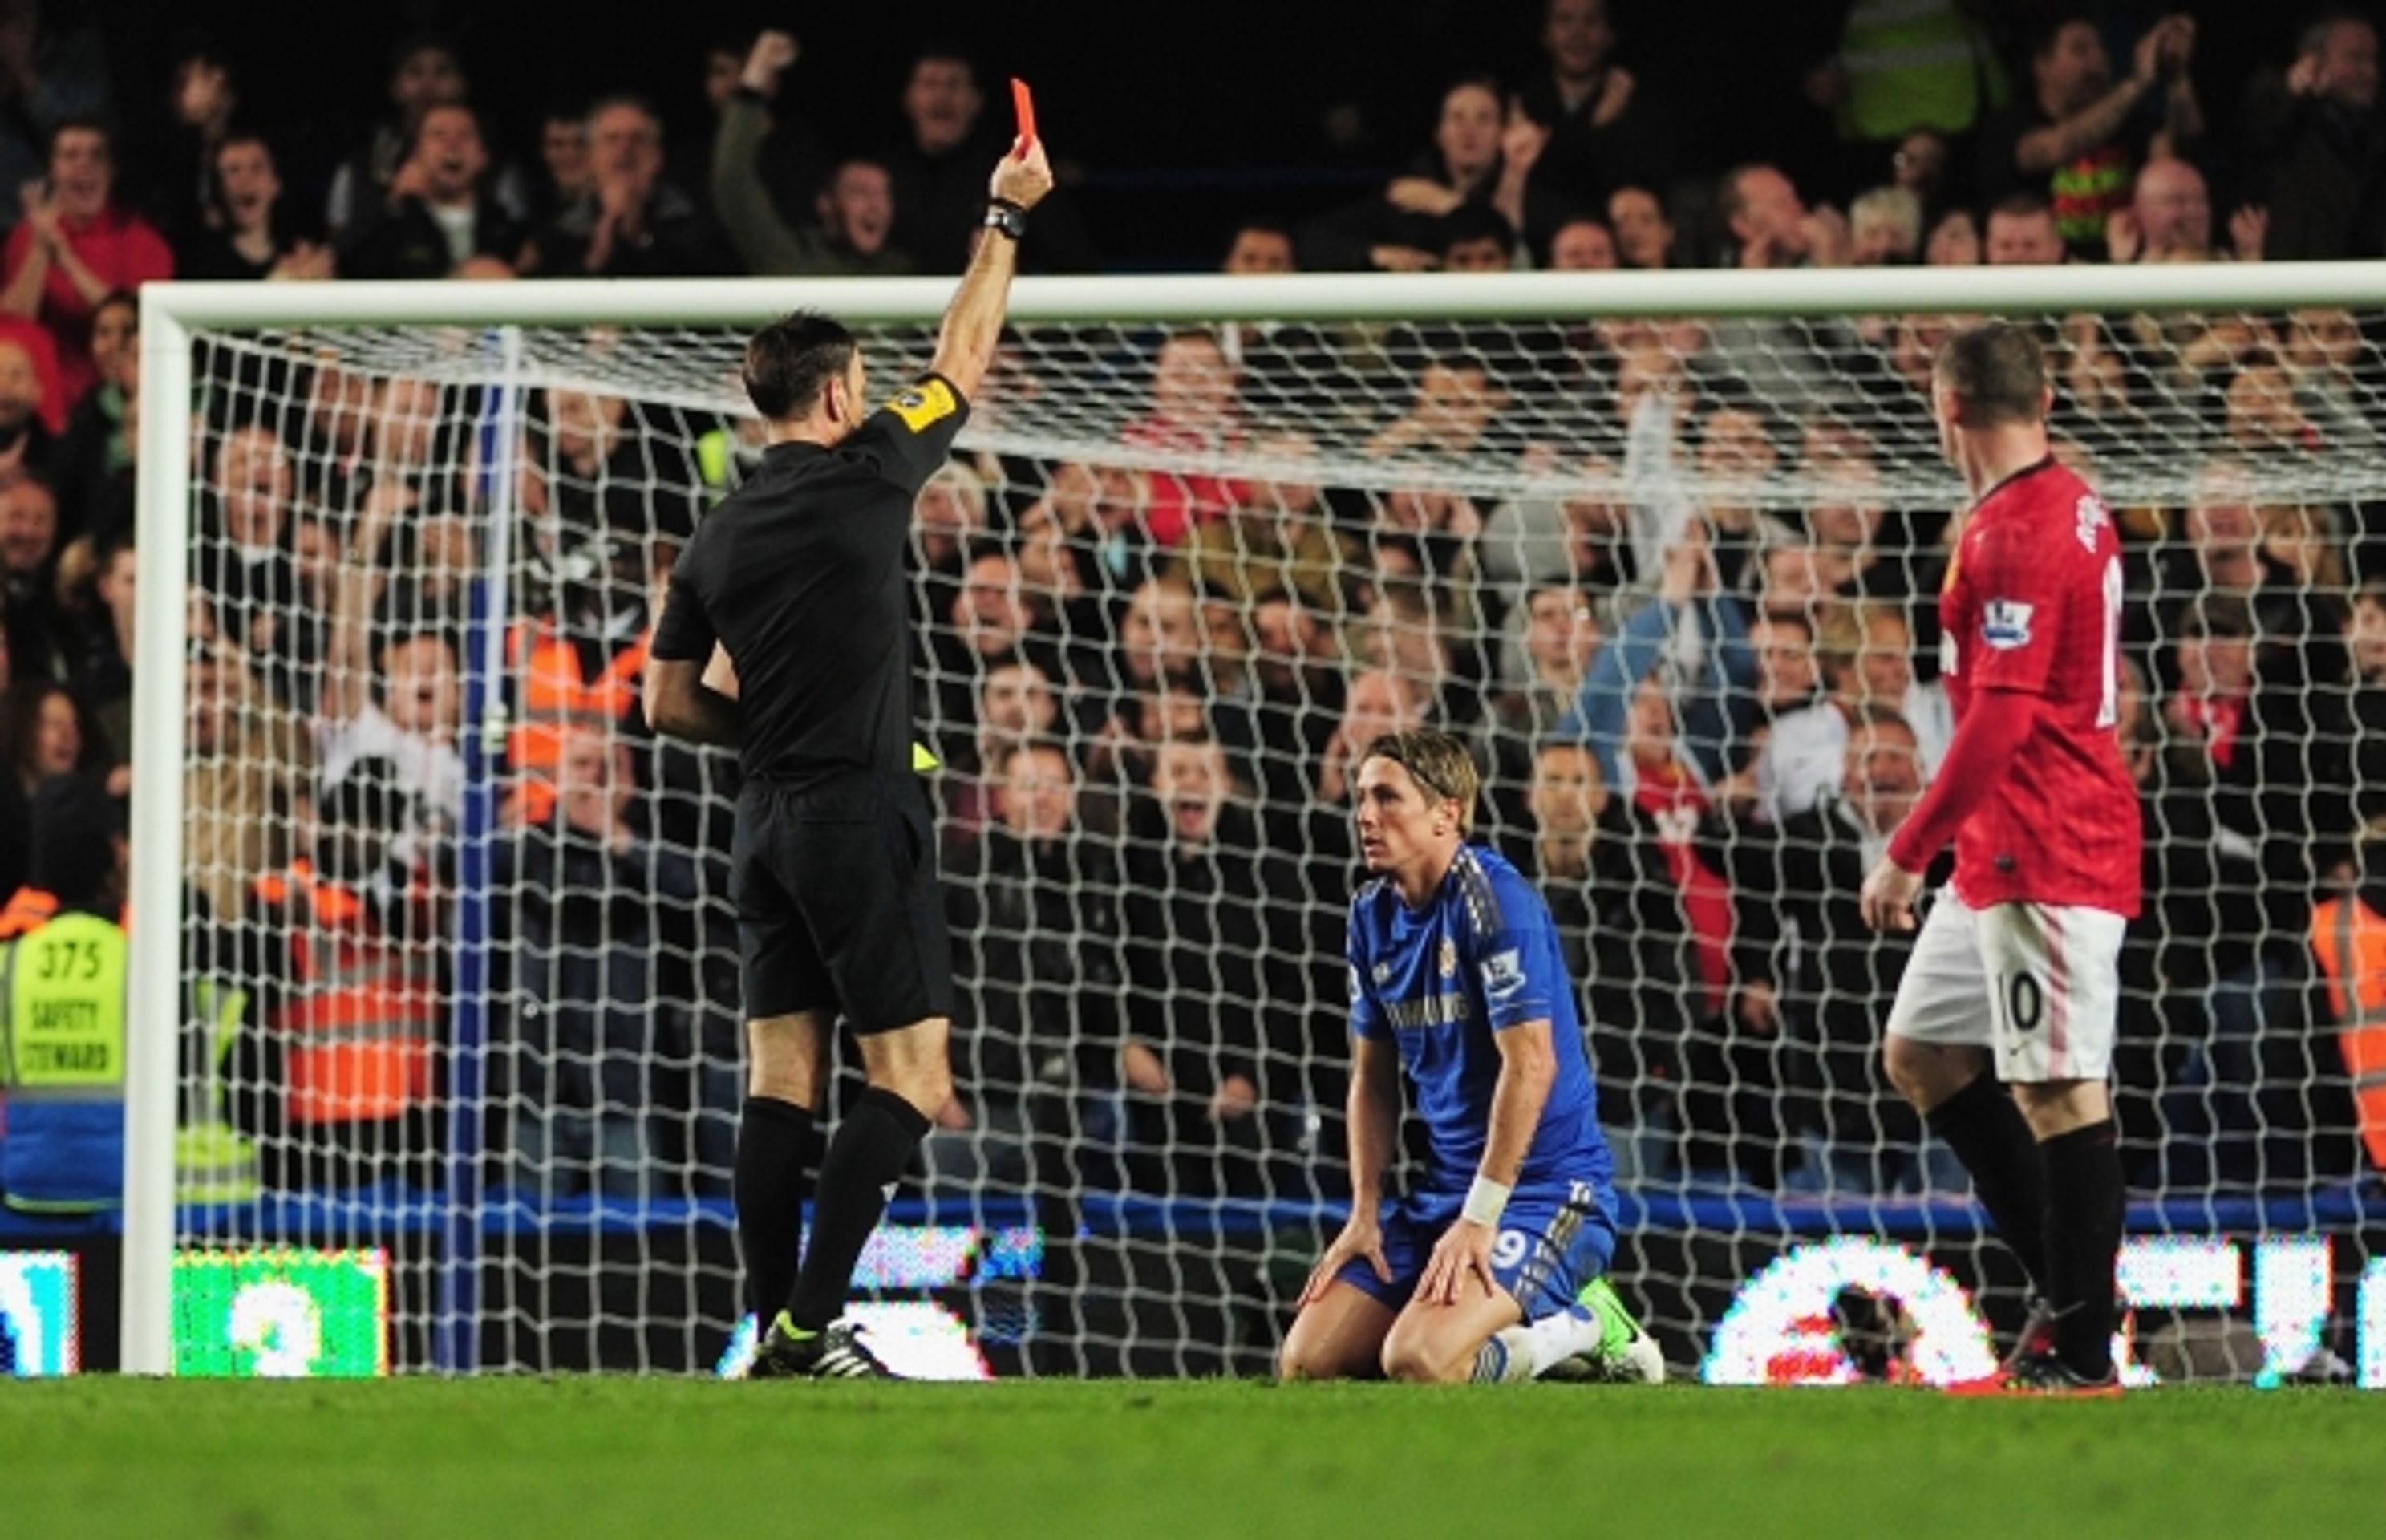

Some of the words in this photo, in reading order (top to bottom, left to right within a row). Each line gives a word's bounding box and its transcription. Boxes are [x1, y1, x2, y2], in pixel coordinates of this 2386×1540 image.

[39, 941, 101, 980] 375
[30, 999, 98, 1031] SAFETY
[1381, 991, 1470, 1030] AMSUNG
[1997, 969, 2042, 1033] 10
[22, 1041, 108, 1072] STEWARD
[1490, 1229, 1527, 1269] 9
